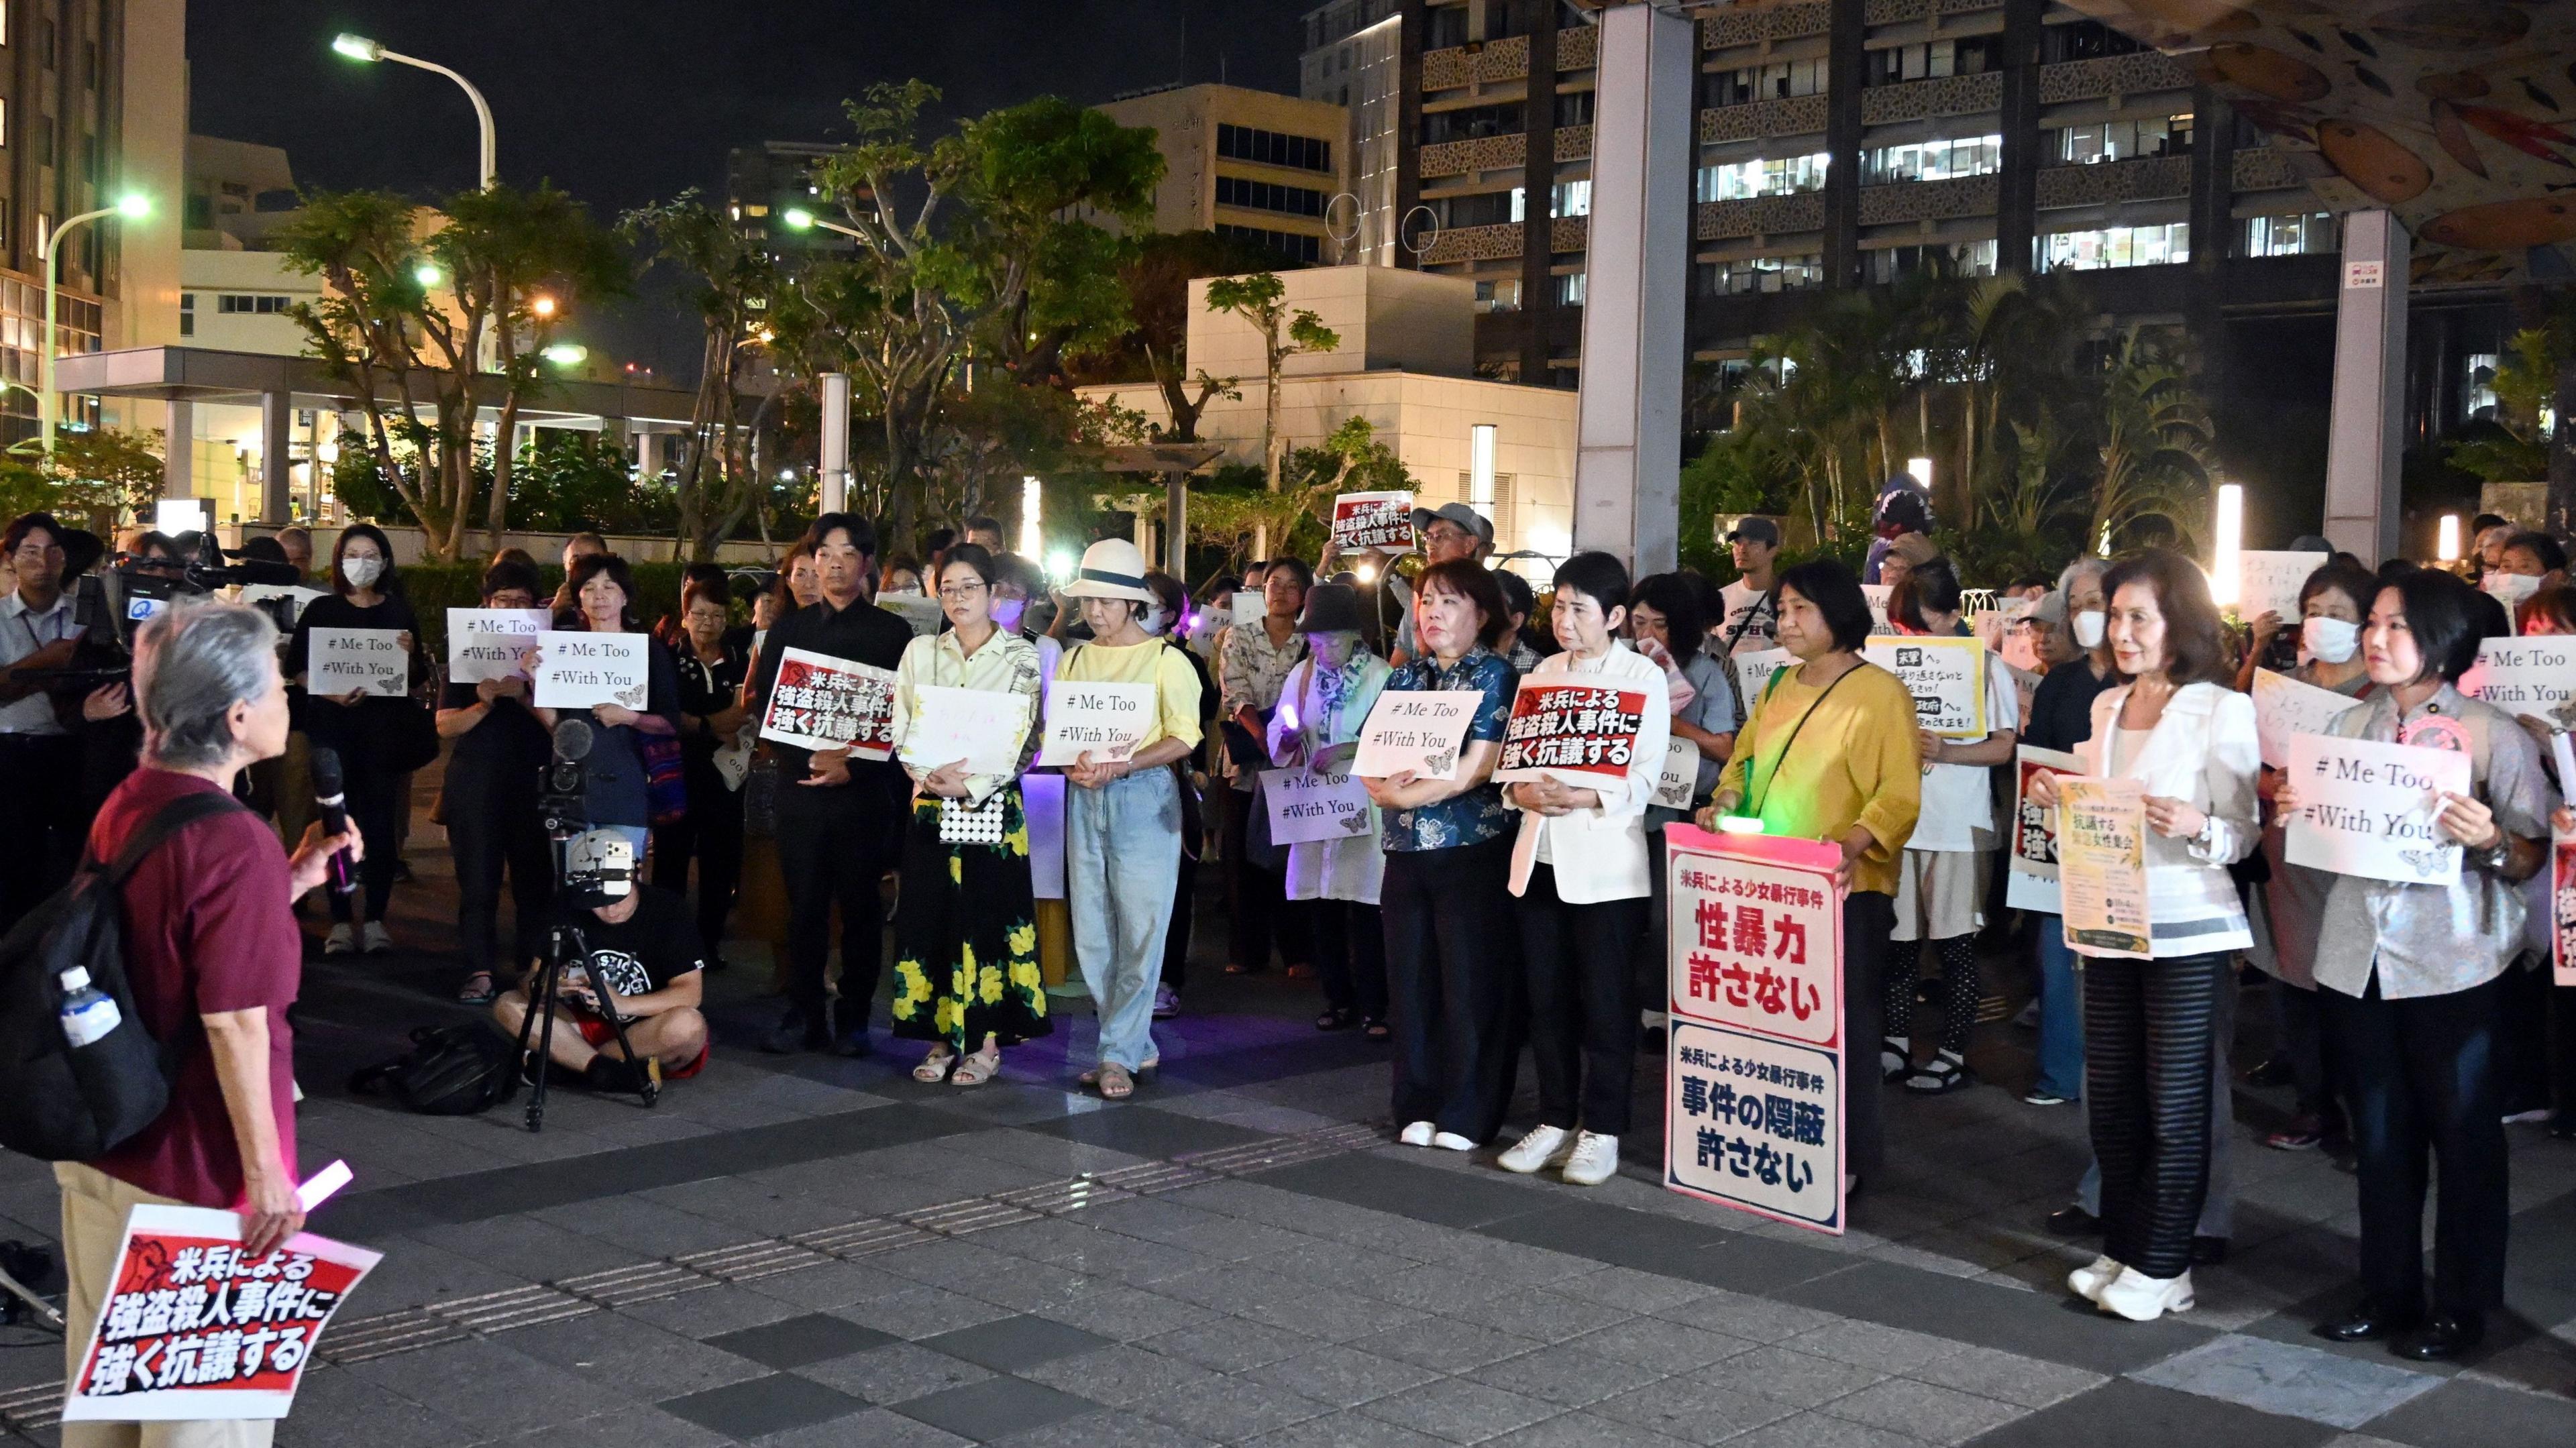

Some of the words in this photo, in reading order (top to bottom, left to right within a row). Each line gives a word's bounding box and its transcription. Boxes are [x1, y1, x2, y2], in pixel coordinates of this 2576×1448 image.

[1352, 500, 1397, 516] 米兵による
[1336, 511, 1410, 533] 強盗殺人事件に
[480, 620, 502, 633] Me
[508, 620, 537, 633] Too
[1220, 617, 1230, 626] M
[340, 638, 364, 651] Me
[367, 639, 393, 651] Too
[462, 647, 506, 661] #With
[511, 647, 527, 661] Yo
[572, 644, 596, 657] Me
[601, 644, 631, 658] Too
[323, 662, 365, 675] #With
[368, 663, 394, 676] You
[2494, 651, 2523, 667] Me
[2529, 650, 2566, 666] Too
[552, 671, 598, 685] #With
[604, 672, 632, 686] You
[1755, 663, 1772, 678] Me
[810, 671, 888, 698] 米兵による
[2472, 685, 2526, 702] #With
[2532, 685, 2571, 701] You
[1080, 694, 1104, 710] Me
[1109, 695, 1136, 712] Too
[1403, 702, 1428, 716] Me
[1433, 703, 1459, 717] Too
[1538, 689, 1619, 711] 米兵による
[773, 708, 894, 742] 強く抗議する
[1059, 726, 1102, 742] #With
[1108, 728, 1132, 742] You
[1509, 709, 1638, 741] 強盗殺人事件に
[1372, 730, 1415, 746] #With
[1421, 732, 1446, 748] You
[1501, 736, 1631, 770] 強く抗議する
[1293, 774, 1319, 789] Me
[1325, 771, 1349, 785] Too
[1661, 771, 1680, 783] ou
[2336, 757, 2375, 783] Me
[2385, 763, 2433, 790] Too
[1283, 801, 1324, 820] #With
[1328, 799, 1355, 814] You
[2304, 803, 2372, 834] #With
[2383, 813, 2433, 840] You
[1680, 869, 1824, 910] 米兵による少女暴行事件
[1695, 899, 1806, 965] 性暴力
[1688, 951, 1821, 1021] 許さない
[1680, 1046, 1825, 1095] 米兵による少女暴行事件
[1682, 1074, 1825, 1148] 事件の隠蔽
[1697, 1125, 1813, 1193] 許さない
[170, 1245, 315, 1285] 米兵による
[105, 1280, 335, 1342] 強盗殺人事件に
[89, 1326, 307, 1396] 強く抗議する
